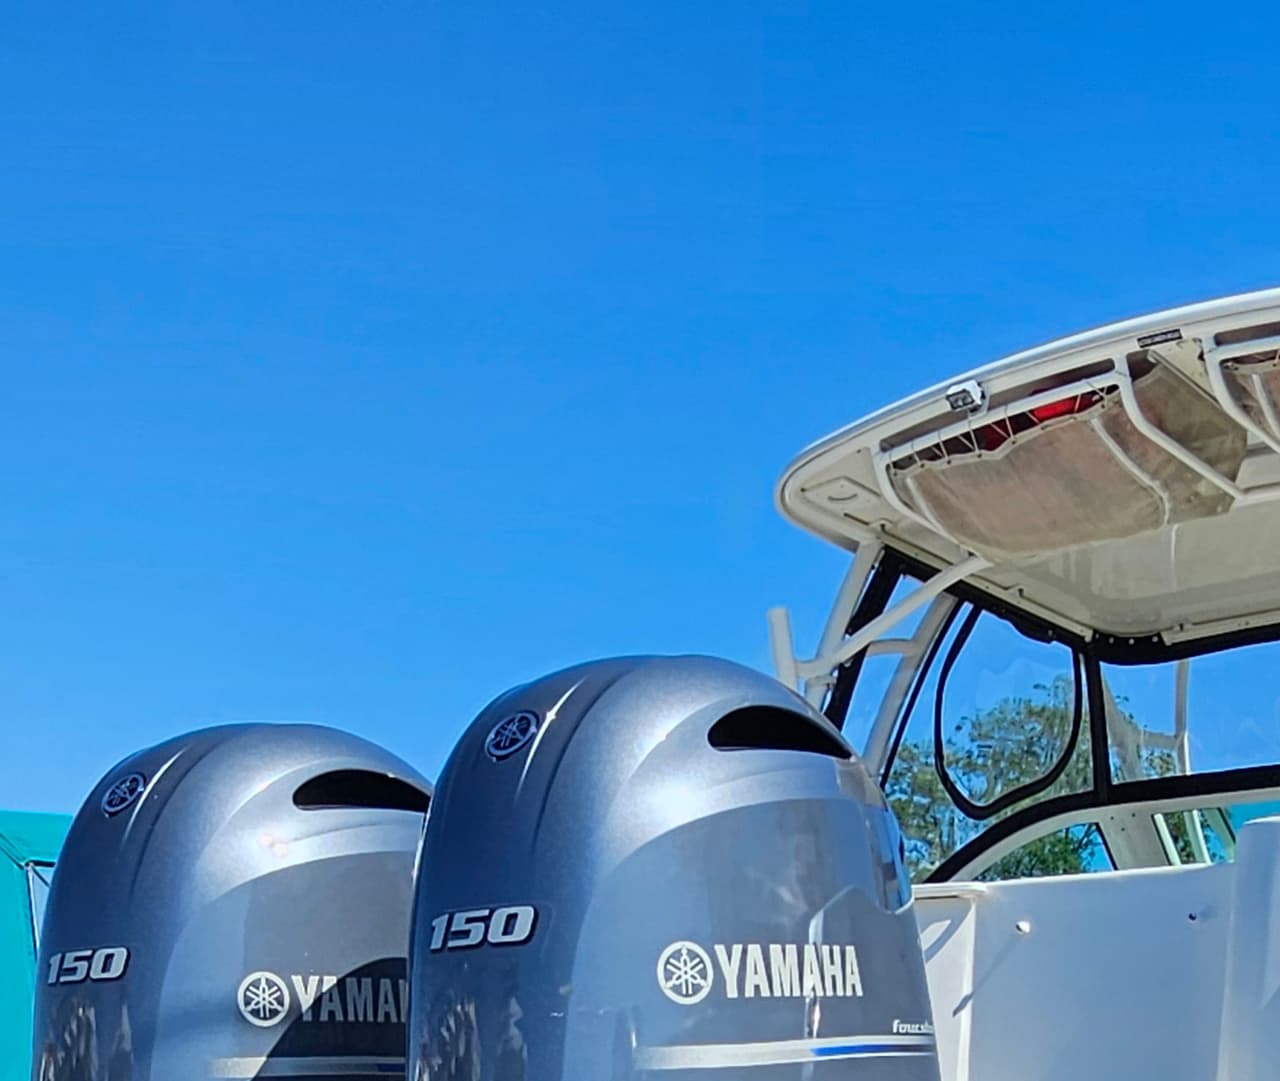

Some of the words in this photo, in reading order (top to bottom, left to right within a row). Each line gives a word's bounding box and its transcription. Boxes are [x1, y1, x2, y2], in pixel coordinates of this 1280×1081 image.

[429, 905, 535, 950] 150
[47, 946, 129, 984] 150
[714, 943, 864, 998] YAMAHA
